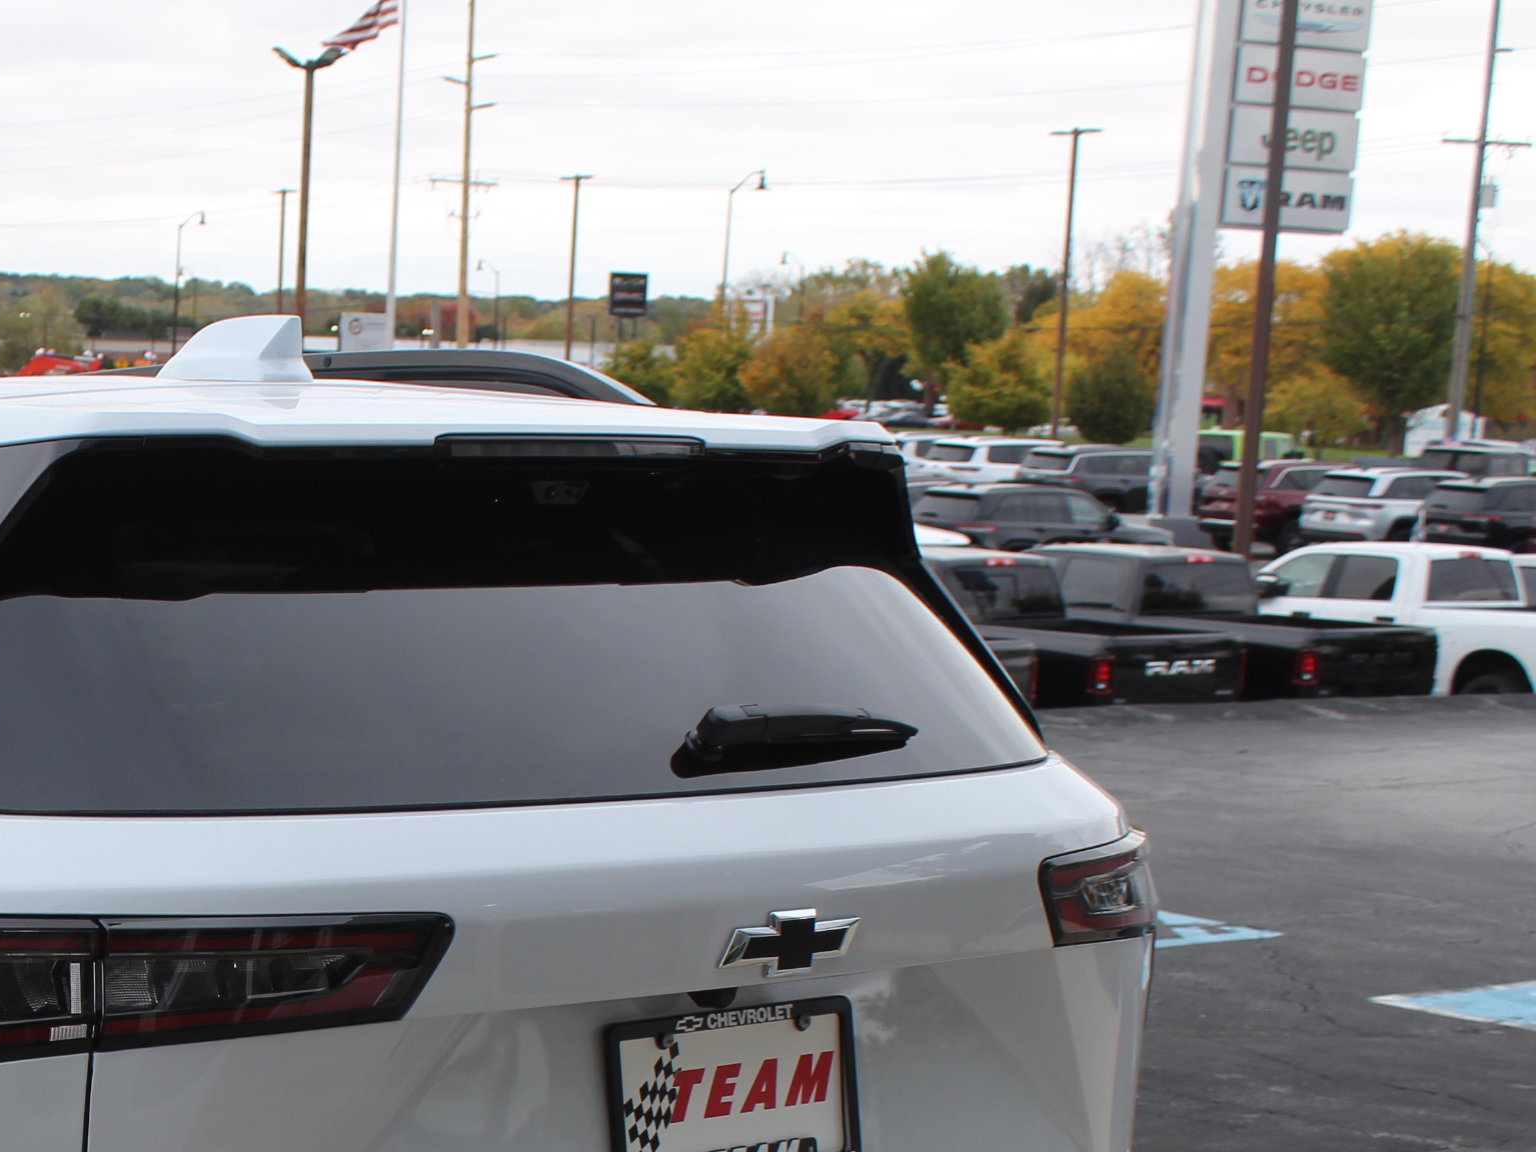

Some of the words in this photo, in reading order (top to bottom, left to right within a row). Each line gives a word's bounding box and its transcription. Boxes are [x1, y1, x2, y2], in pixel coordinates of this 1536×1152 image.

[1254, 0, 1364, 16] CHYSLER
[1245, 66, 1361, 92] DDGE
[1144, 658, 1216, 677] RAM
[706, 1003, 794, 1029] CHEVROLET
[669, 1050, 835, 1124] TEAM
